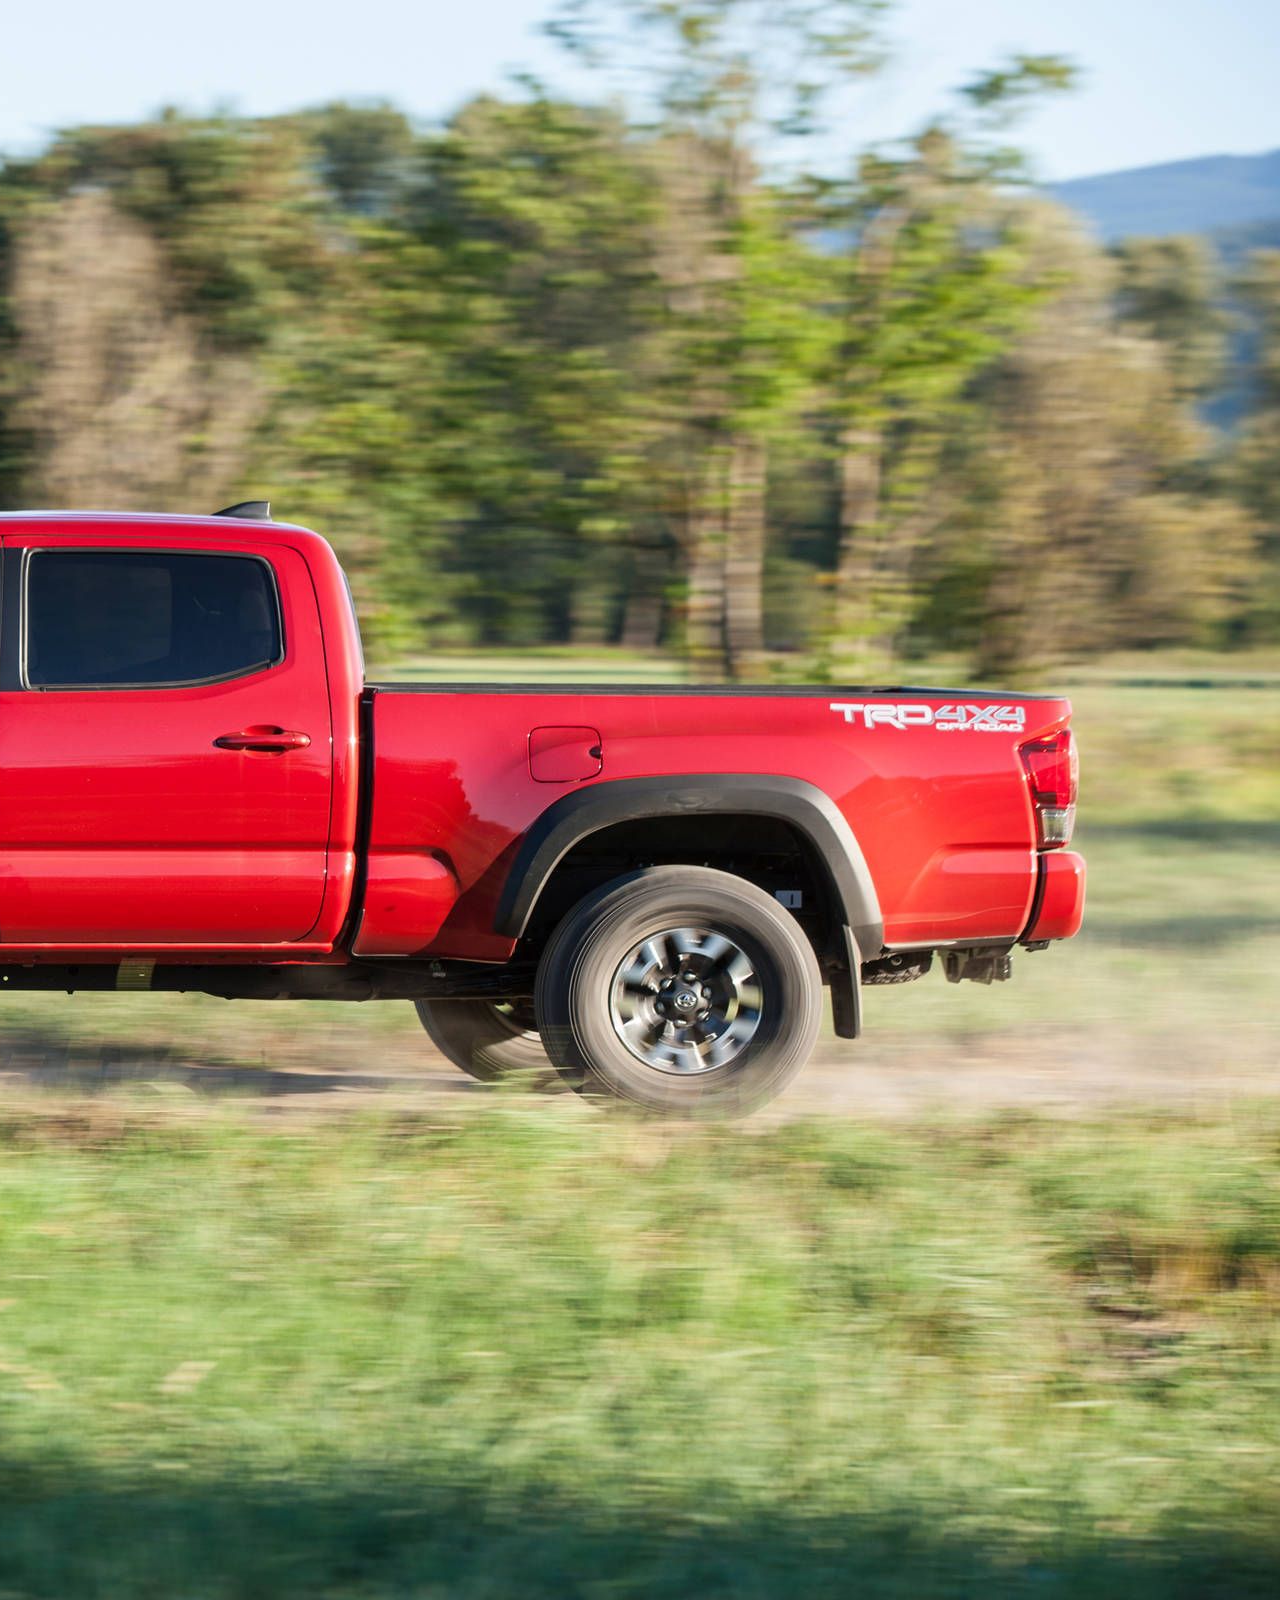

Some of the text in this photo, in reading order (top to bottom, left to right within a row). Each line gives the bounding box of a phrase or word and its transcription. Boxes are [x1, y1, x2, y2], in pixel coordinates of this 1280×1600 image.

[830, 703, 934, 730] TRD
[935, 722, 1024, 732] OFF ROAD
